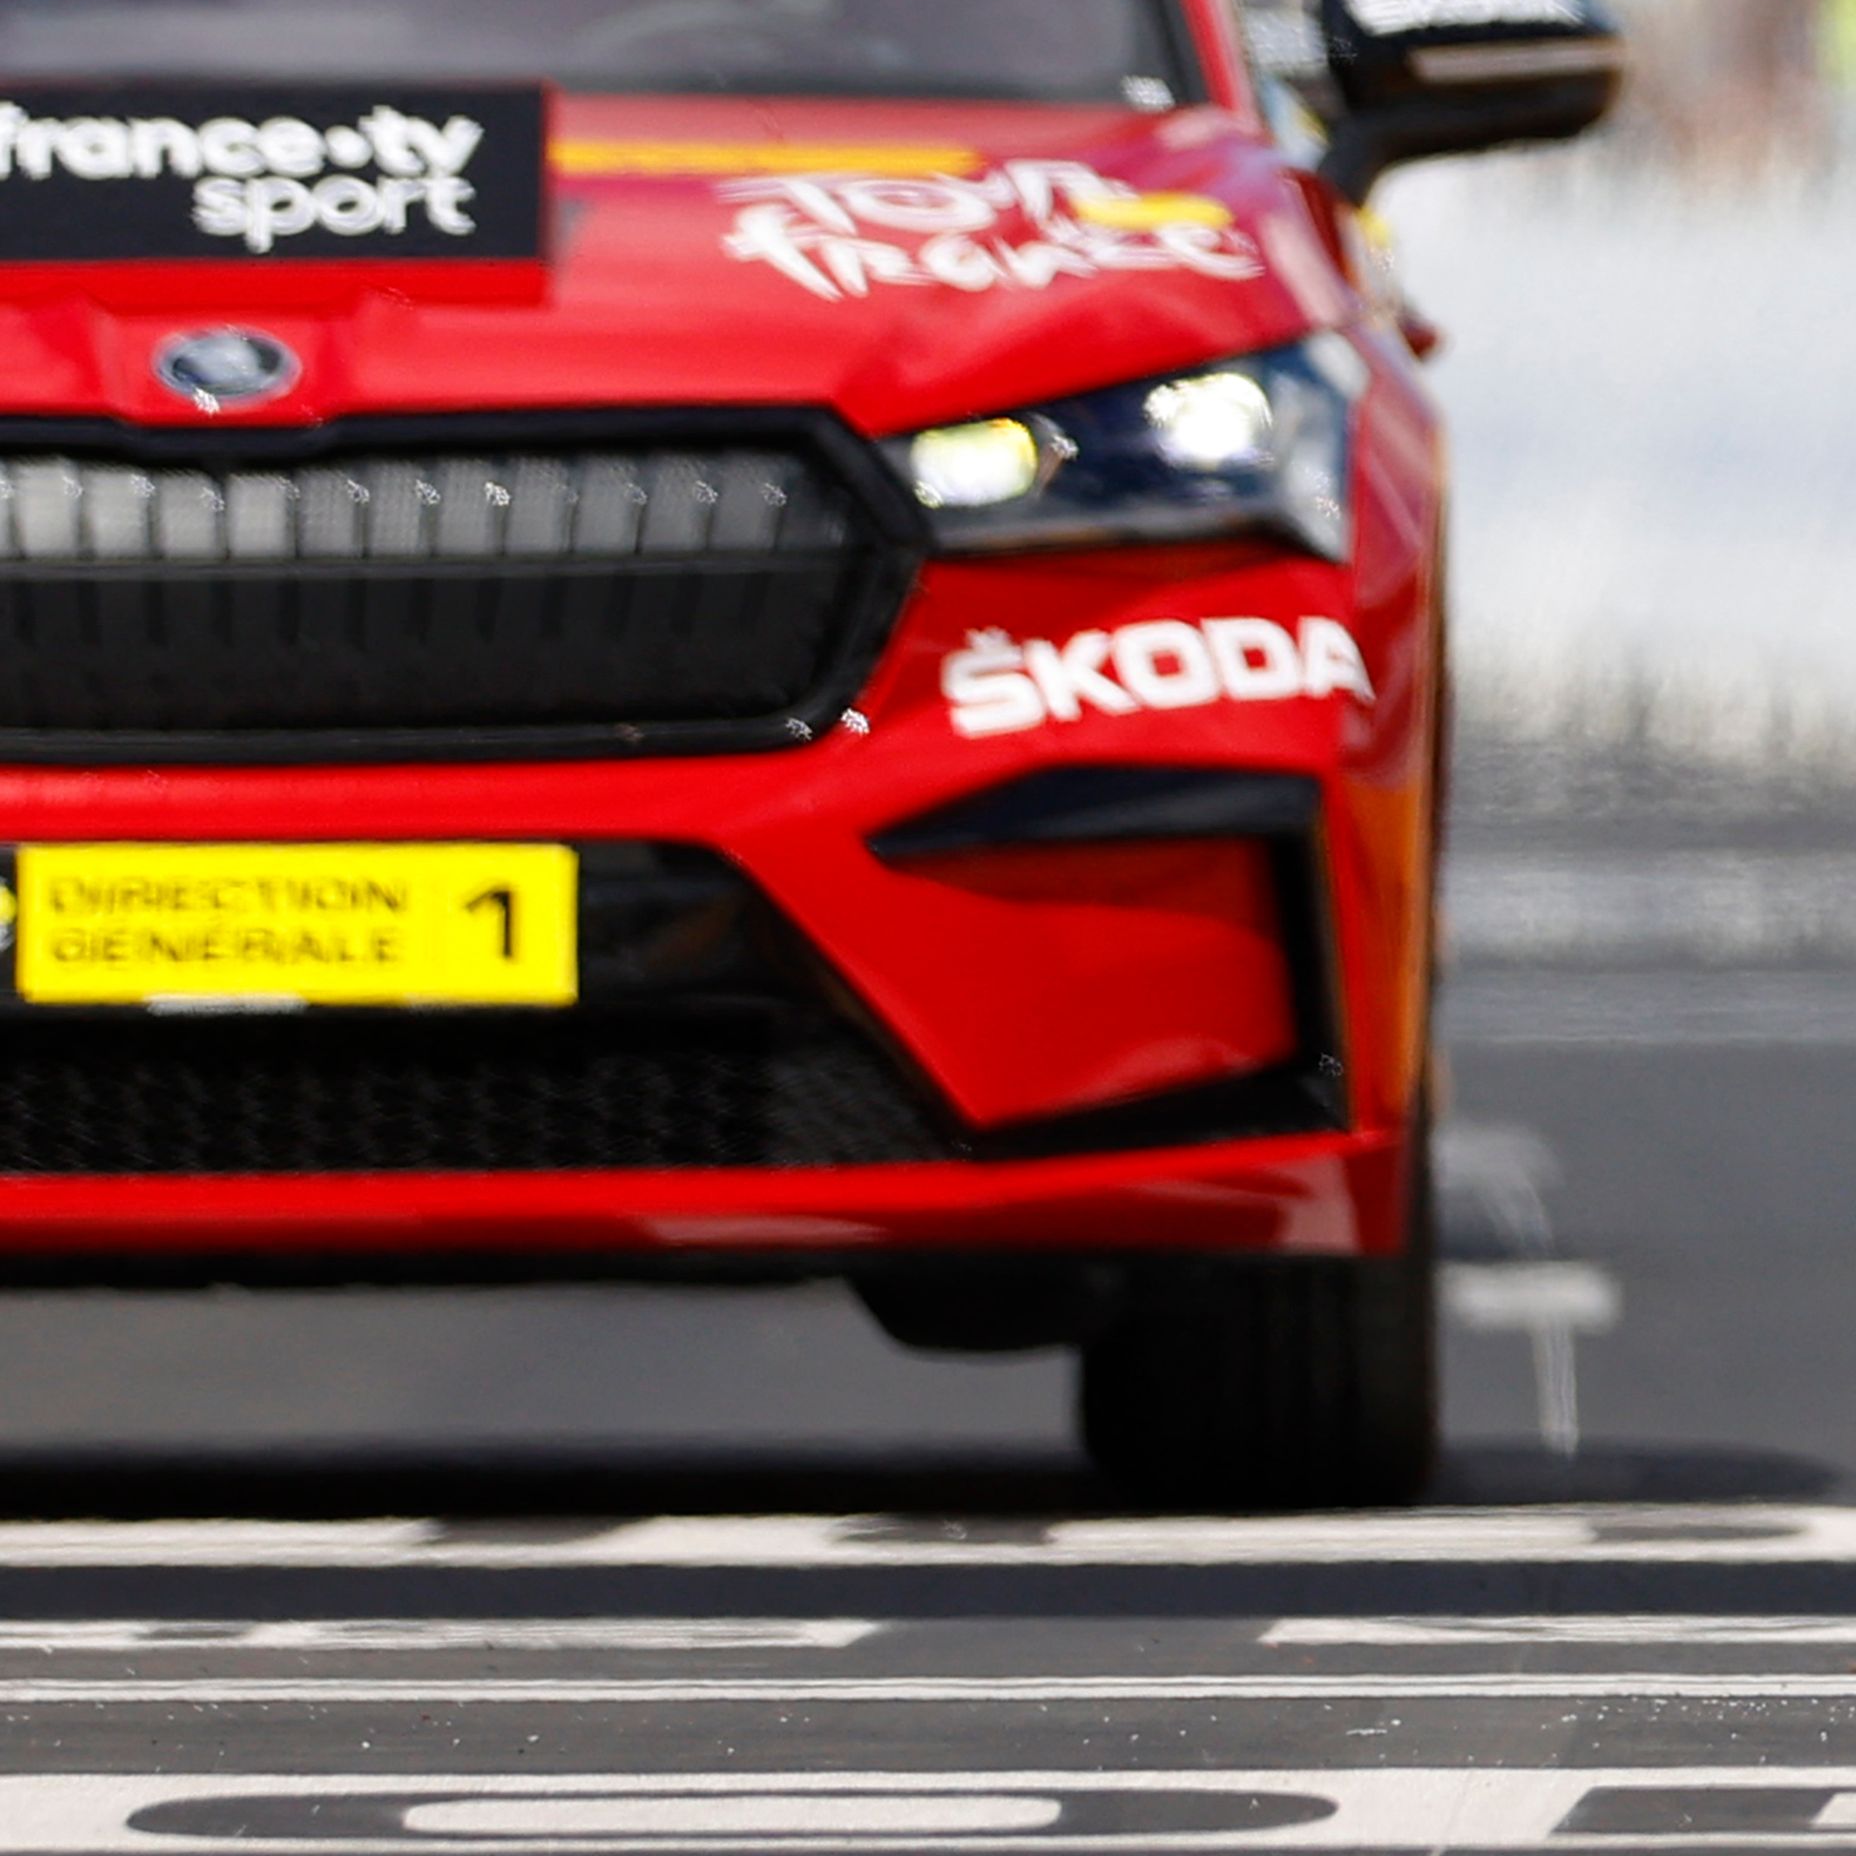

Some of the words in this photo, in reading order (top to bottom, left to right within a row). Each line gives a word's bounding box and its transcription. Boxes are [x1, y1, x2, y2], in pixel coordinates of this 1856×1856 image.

[192, 174, 478, 254] sport
[940, 616, 1376, 738] ŠKODA
[50, 875, 406, 913] DIRECTION
[463, 881, 519, 963] 1
